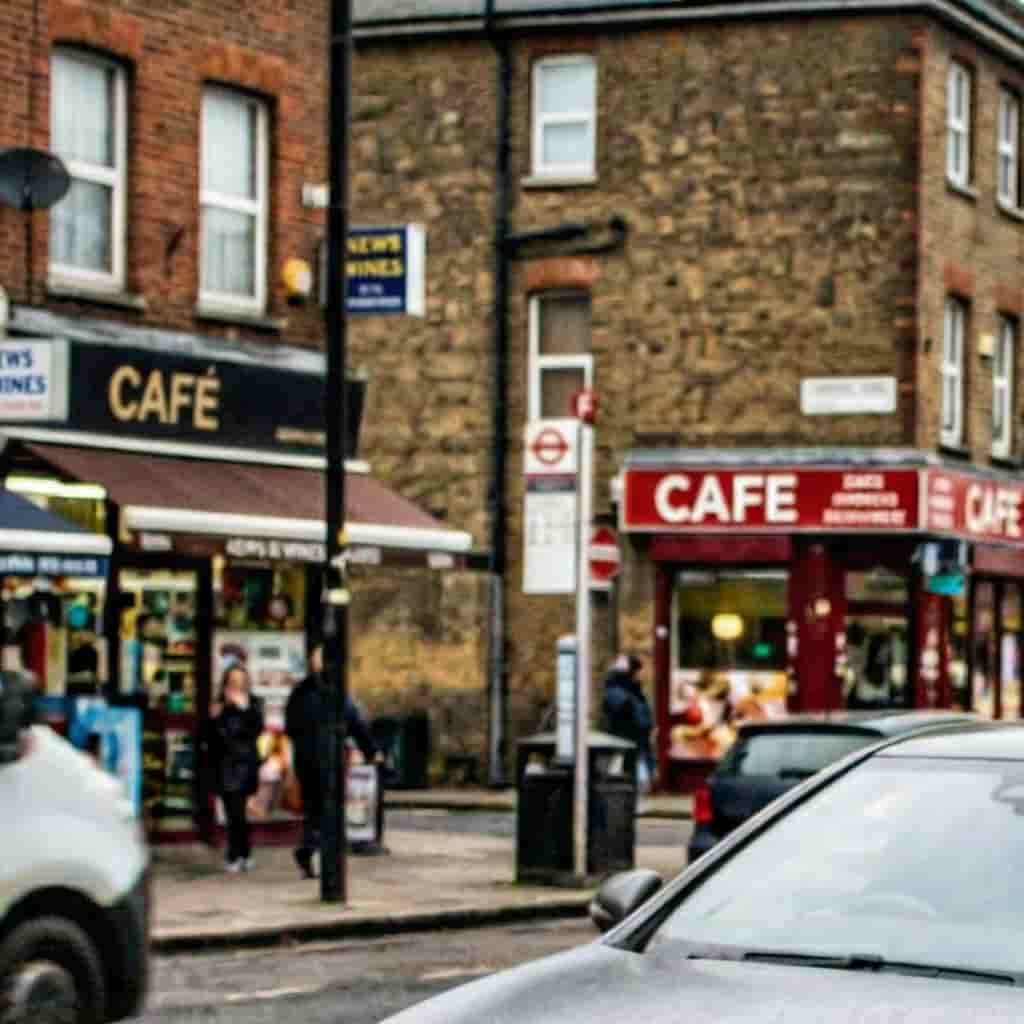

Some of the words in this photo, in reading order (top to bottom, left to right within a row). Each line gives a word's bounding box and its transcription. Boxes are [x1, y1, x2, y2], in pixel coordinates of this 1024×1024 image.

[108, 365, 221, 430] CAFÉ
[654, 473, 799, 523] CAFE
[965, 483, 1023, 537] CAFE
